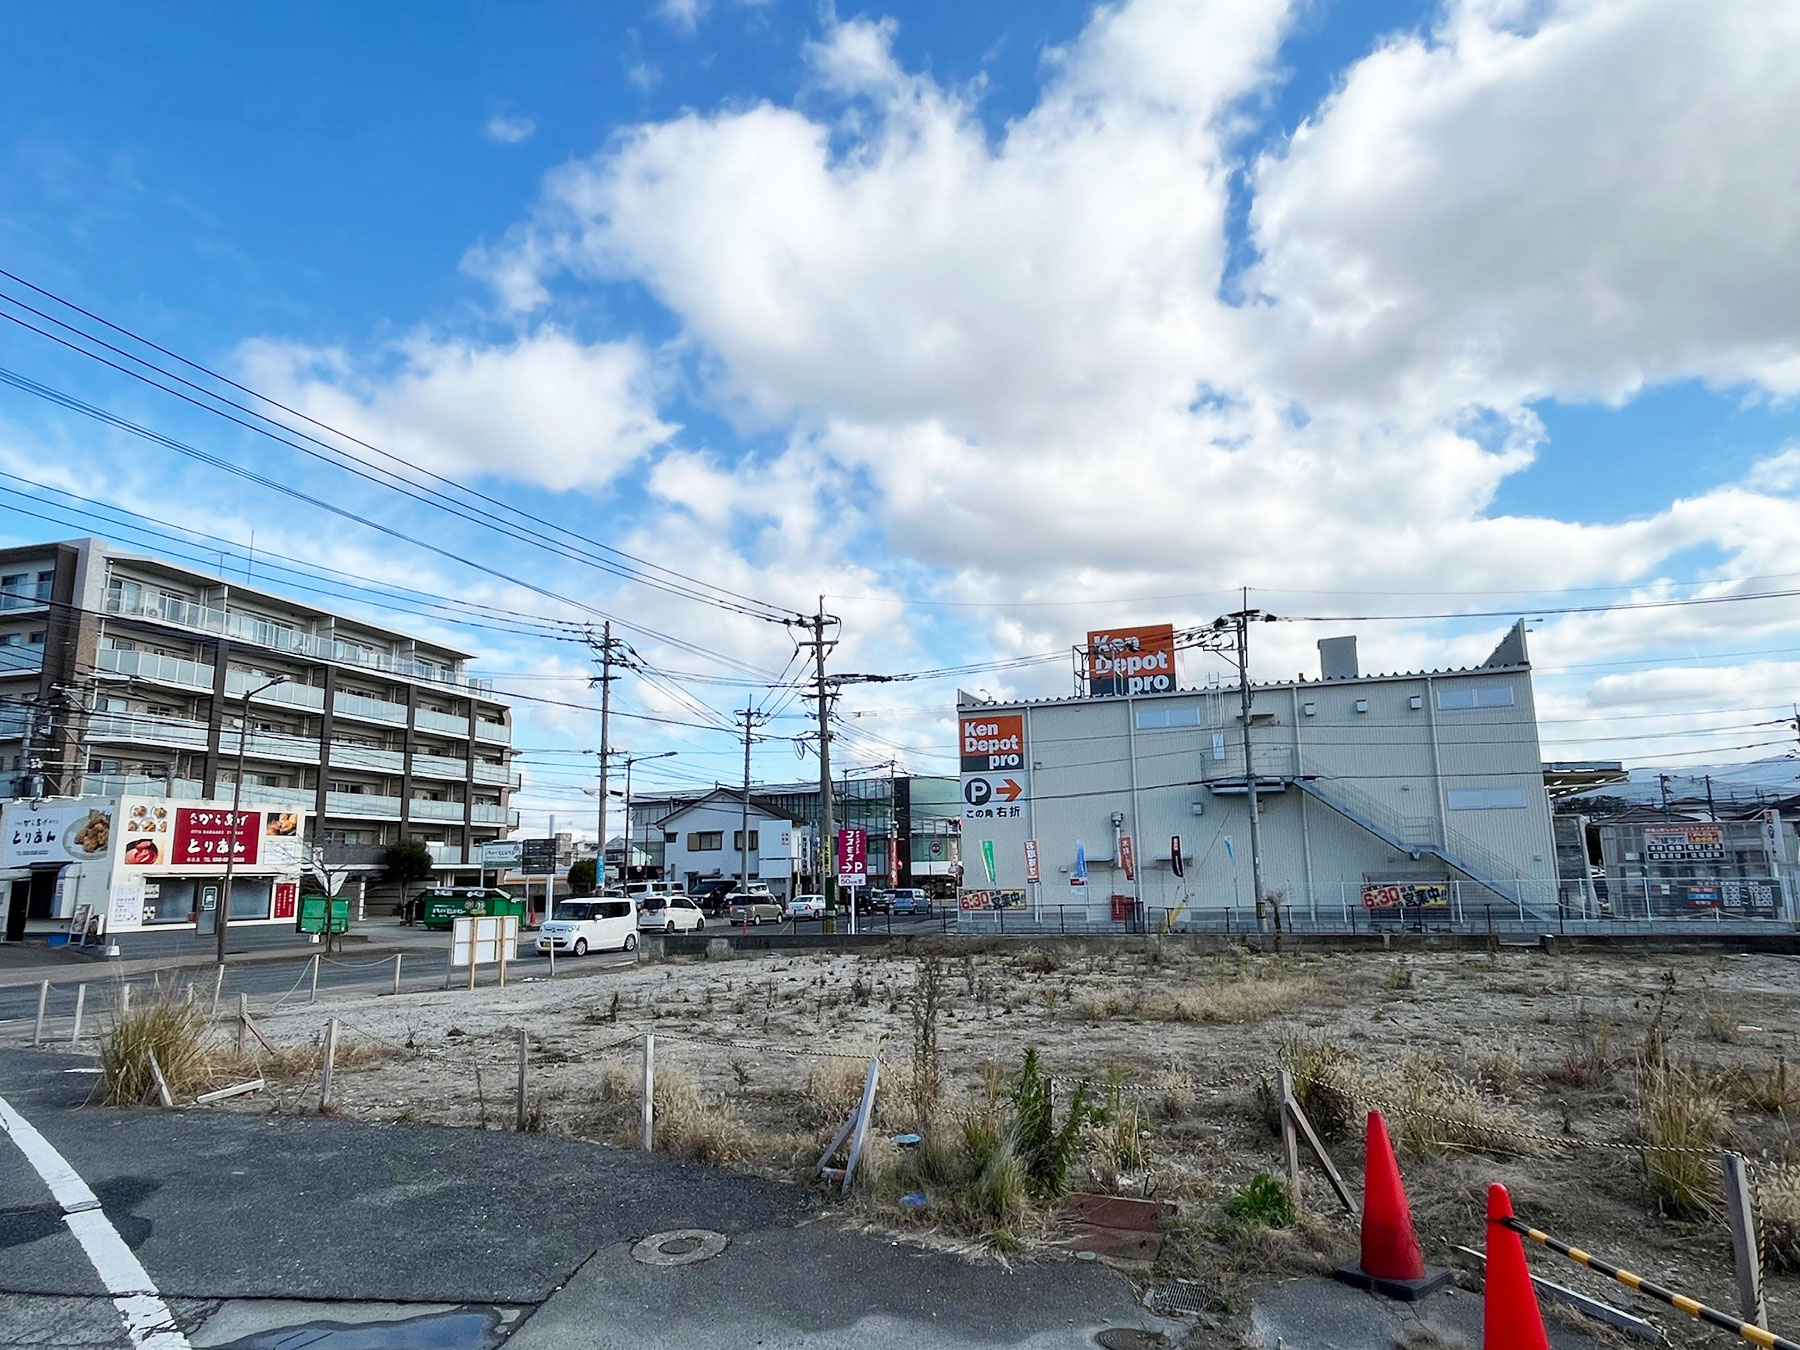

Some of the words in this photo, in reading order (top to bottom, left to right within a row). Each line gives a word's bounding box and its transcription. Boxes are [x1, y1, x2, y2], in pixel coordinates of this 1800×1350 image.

[1093, 635, 1140, 651] Ken
[1095, 650, 1168, 675] Depot
[1128, 674, 1169, 696] pro
[964, 722, 999, 737] Ken
[965, 735, 1019, 754] Depot
[989, 753, 1020, 770] pro
[845, 830, 855, 862] コスモス
[854, 861, 863, 873] P
[961, 891, 989, 909] 6:30
[1363, 887, 1400, 908] 6:30
